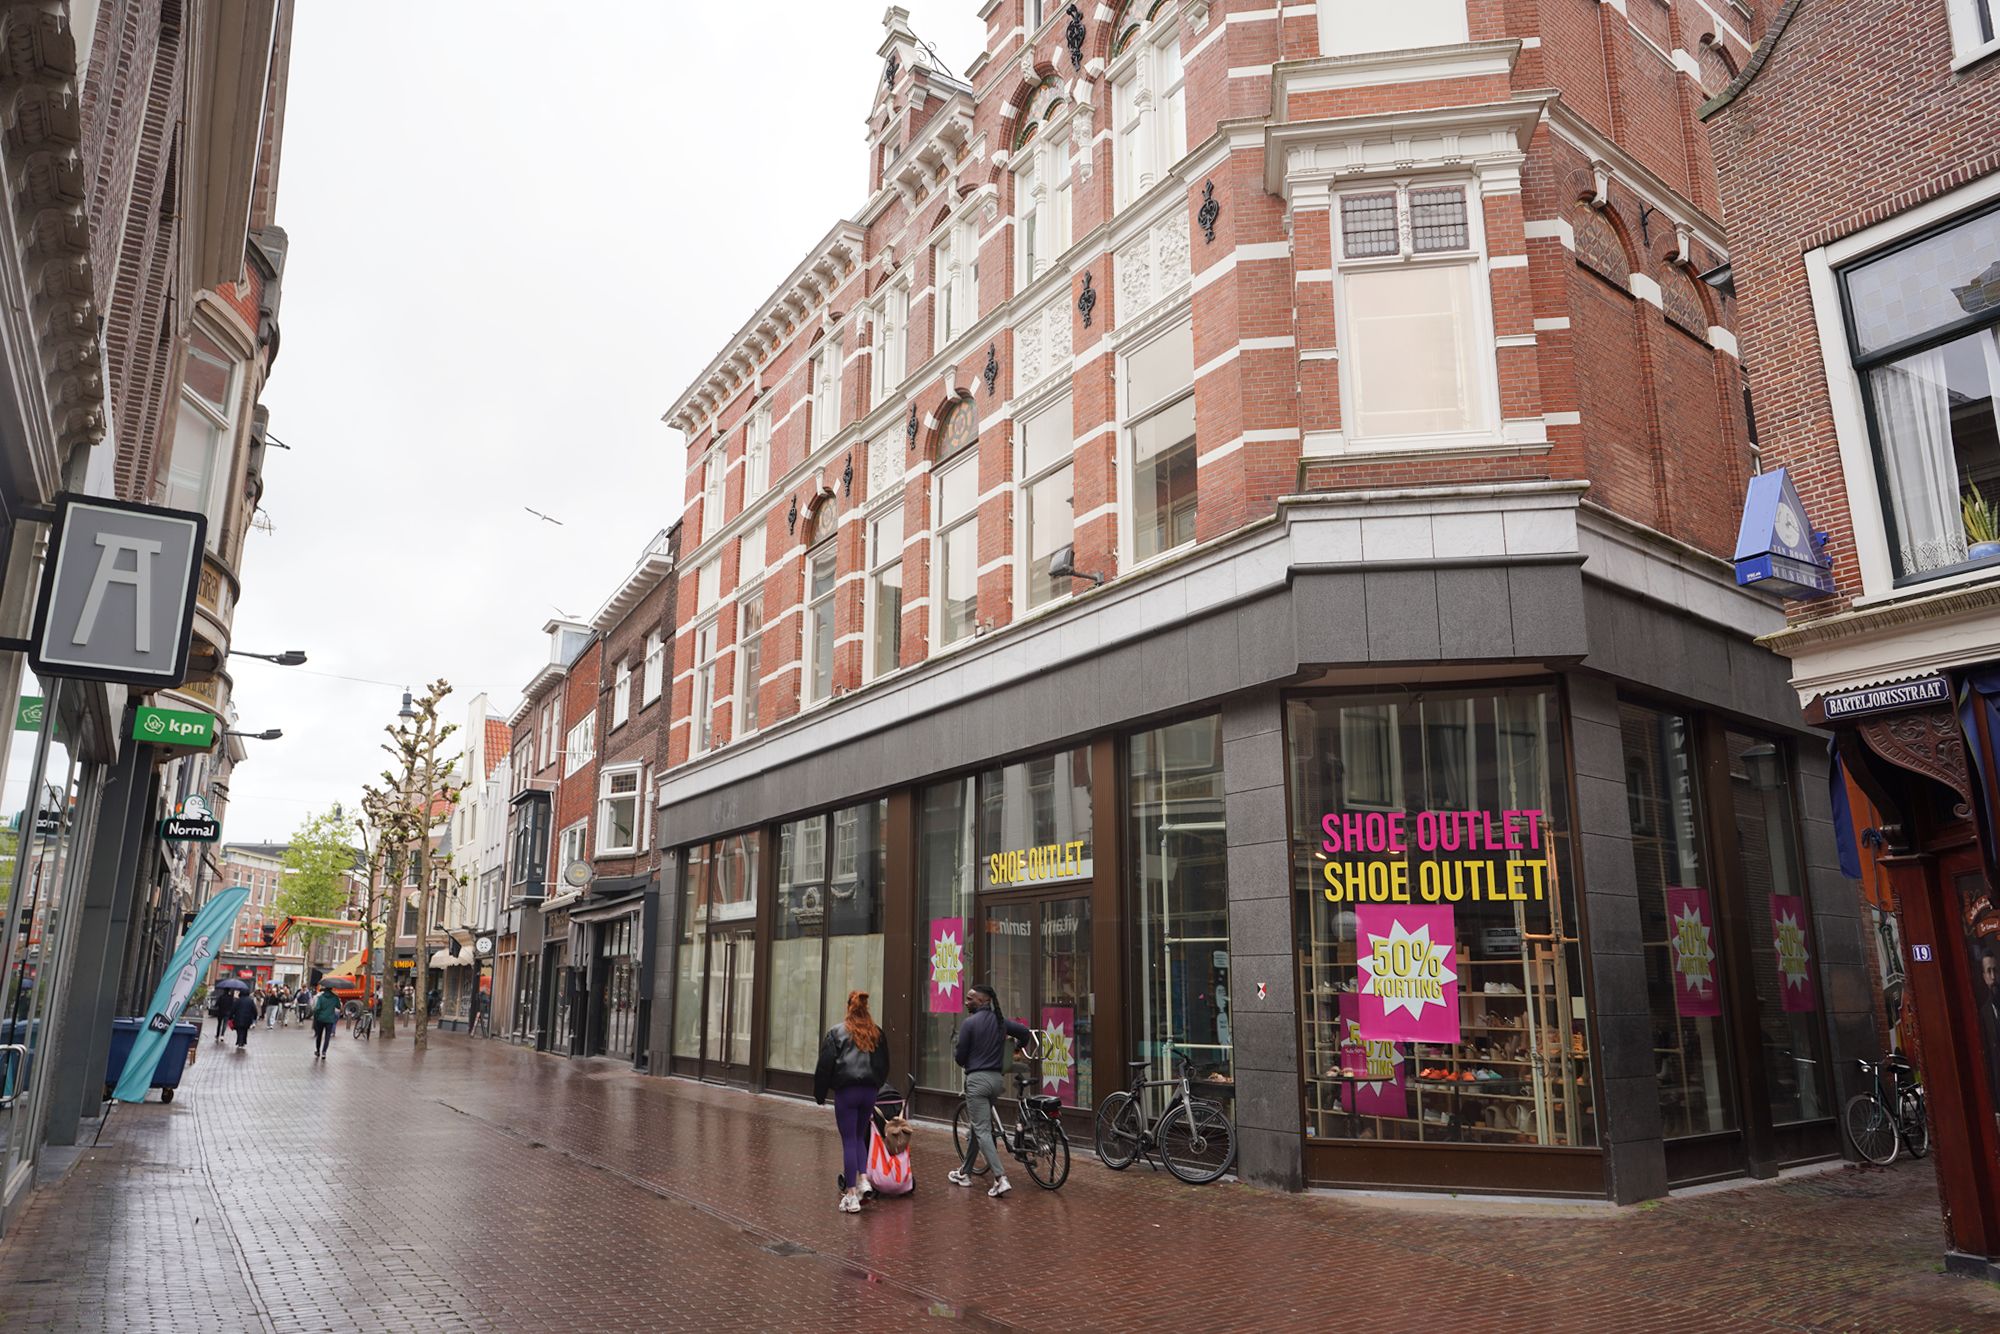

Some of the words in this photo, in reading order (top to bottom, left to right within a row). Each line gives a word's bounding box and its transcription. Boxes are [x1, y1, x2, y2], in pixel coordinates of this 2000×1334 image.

[1828, 681, 1941, 714] BARTELJORISSTRAAT
[168, 718, 205, 736] kpn
[168, 821, 214, 837] Normal
[1321, 812, 1408, 853] SHOE
[1416, 809, 1543, 851] OUTLET
[989, 849, 1025, 885] SHOE
[1028, 840, 1084, 881] OUTLET
[1323, 861, 1411, 903] SHOE
[1418, 859, 1548, 902] OUTLET
[935, 943, 958, 969] 50%
[1372, 940, 1442, 977] 50%
[1914, 946, 1929, 960] 19
[1373, 978, 1443, 999] KORTING
